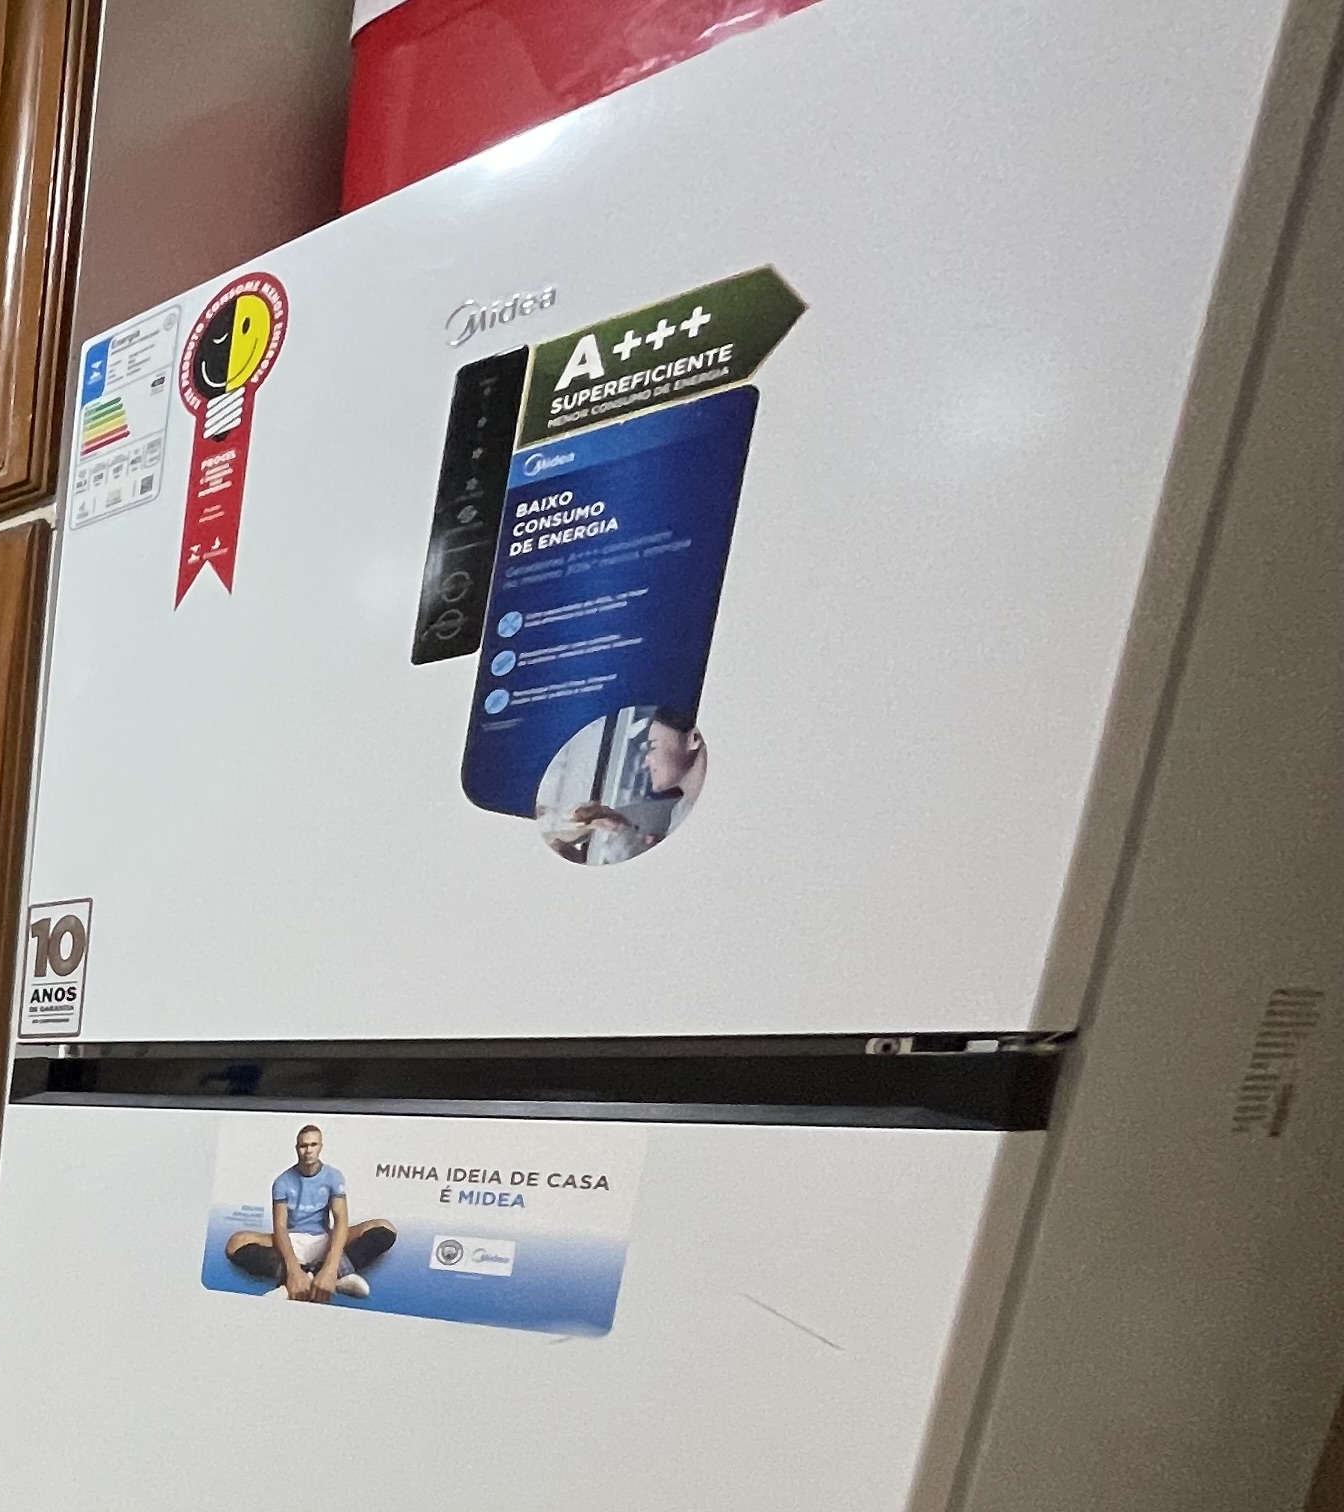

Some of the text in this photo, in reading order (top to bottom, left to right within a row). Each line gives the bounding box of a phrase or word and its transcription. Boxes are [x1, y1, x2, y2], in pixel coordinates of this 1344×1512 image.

[206, 280, 260, 319] CONSOME
[261, 282, 283, 319] MENOS
[445, 285, 556, 347] Midea
[553, 305, 712, 392] A+++
[547, 408, 590, 429] MENOR
[590, 388, 652, 416] CONSUMO
[672, 365, 730, 391] ENERGIA
[550, 343, 734, 415] SUPEREFICIENTE
[523, 452, 575, 477] Midea
[512, 501, 606, 537] CONSUMO
[515, 491, 573, 518] BAIXO
[509, 539, 534, 557] DE
[538, 517, 619, 550] ENERGIA
[31, 914, 85, 978] 10
[30, 986, 77, 1003] ANOS
[375, 1163, 610, 1191] MINHA IDEIA DE CASA
[440, 1185, 526, 1208] É MIDEA
